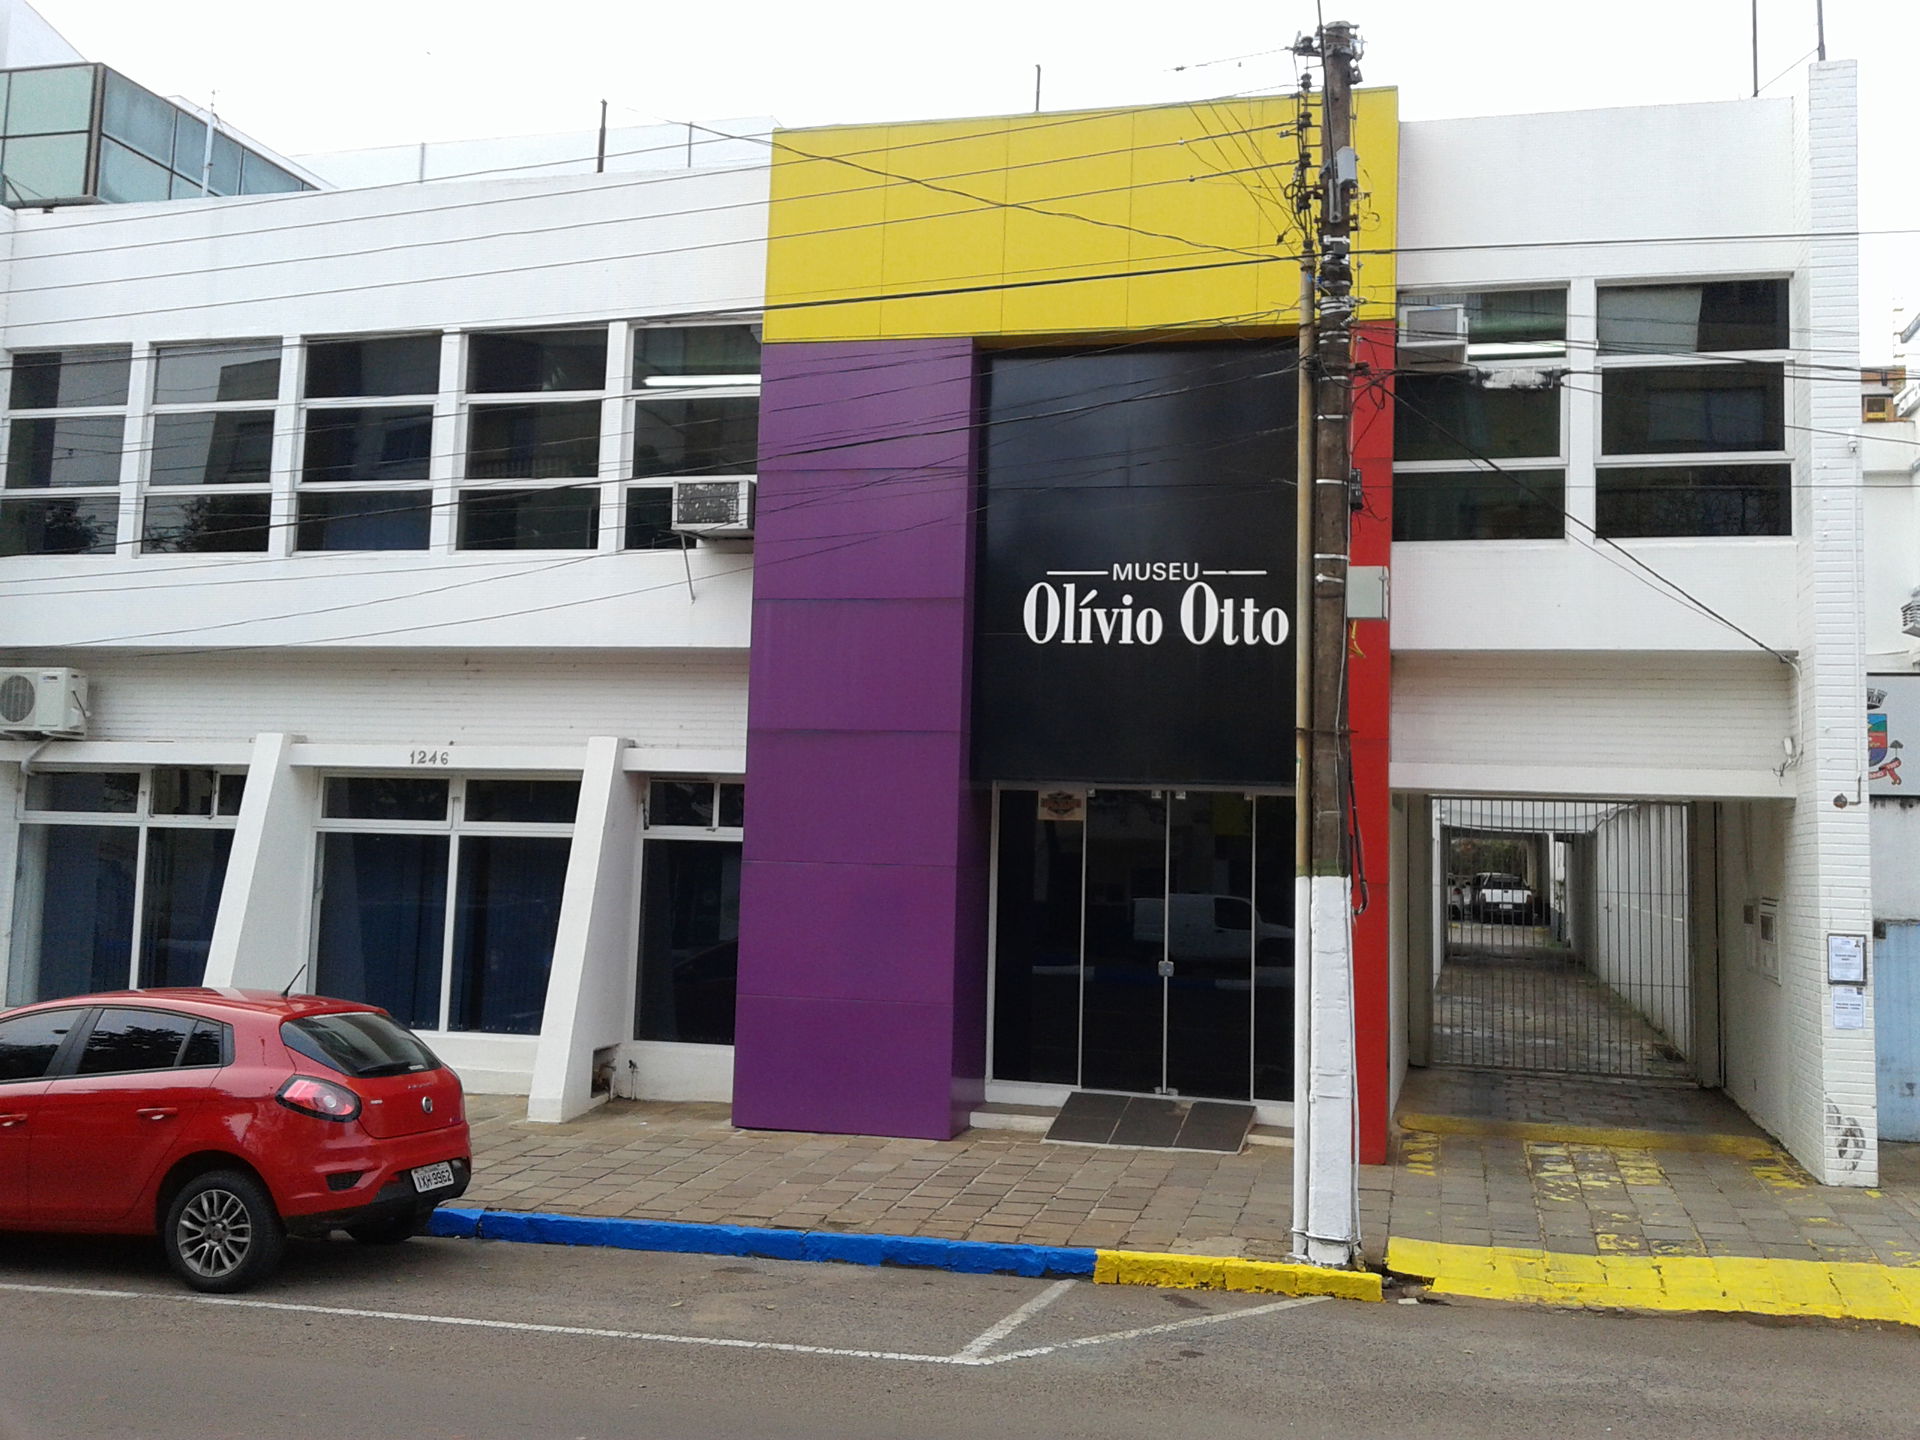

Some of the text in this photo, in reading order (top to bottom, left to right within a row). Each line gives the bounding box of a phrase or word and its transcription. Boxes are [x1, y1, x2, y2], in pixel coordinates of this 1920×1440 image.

[1112, 562, 1199, 581] MUSEU
[1023, 581, 1290, 646] Olívio Otto
[410, 750, 449, 765] 1246
